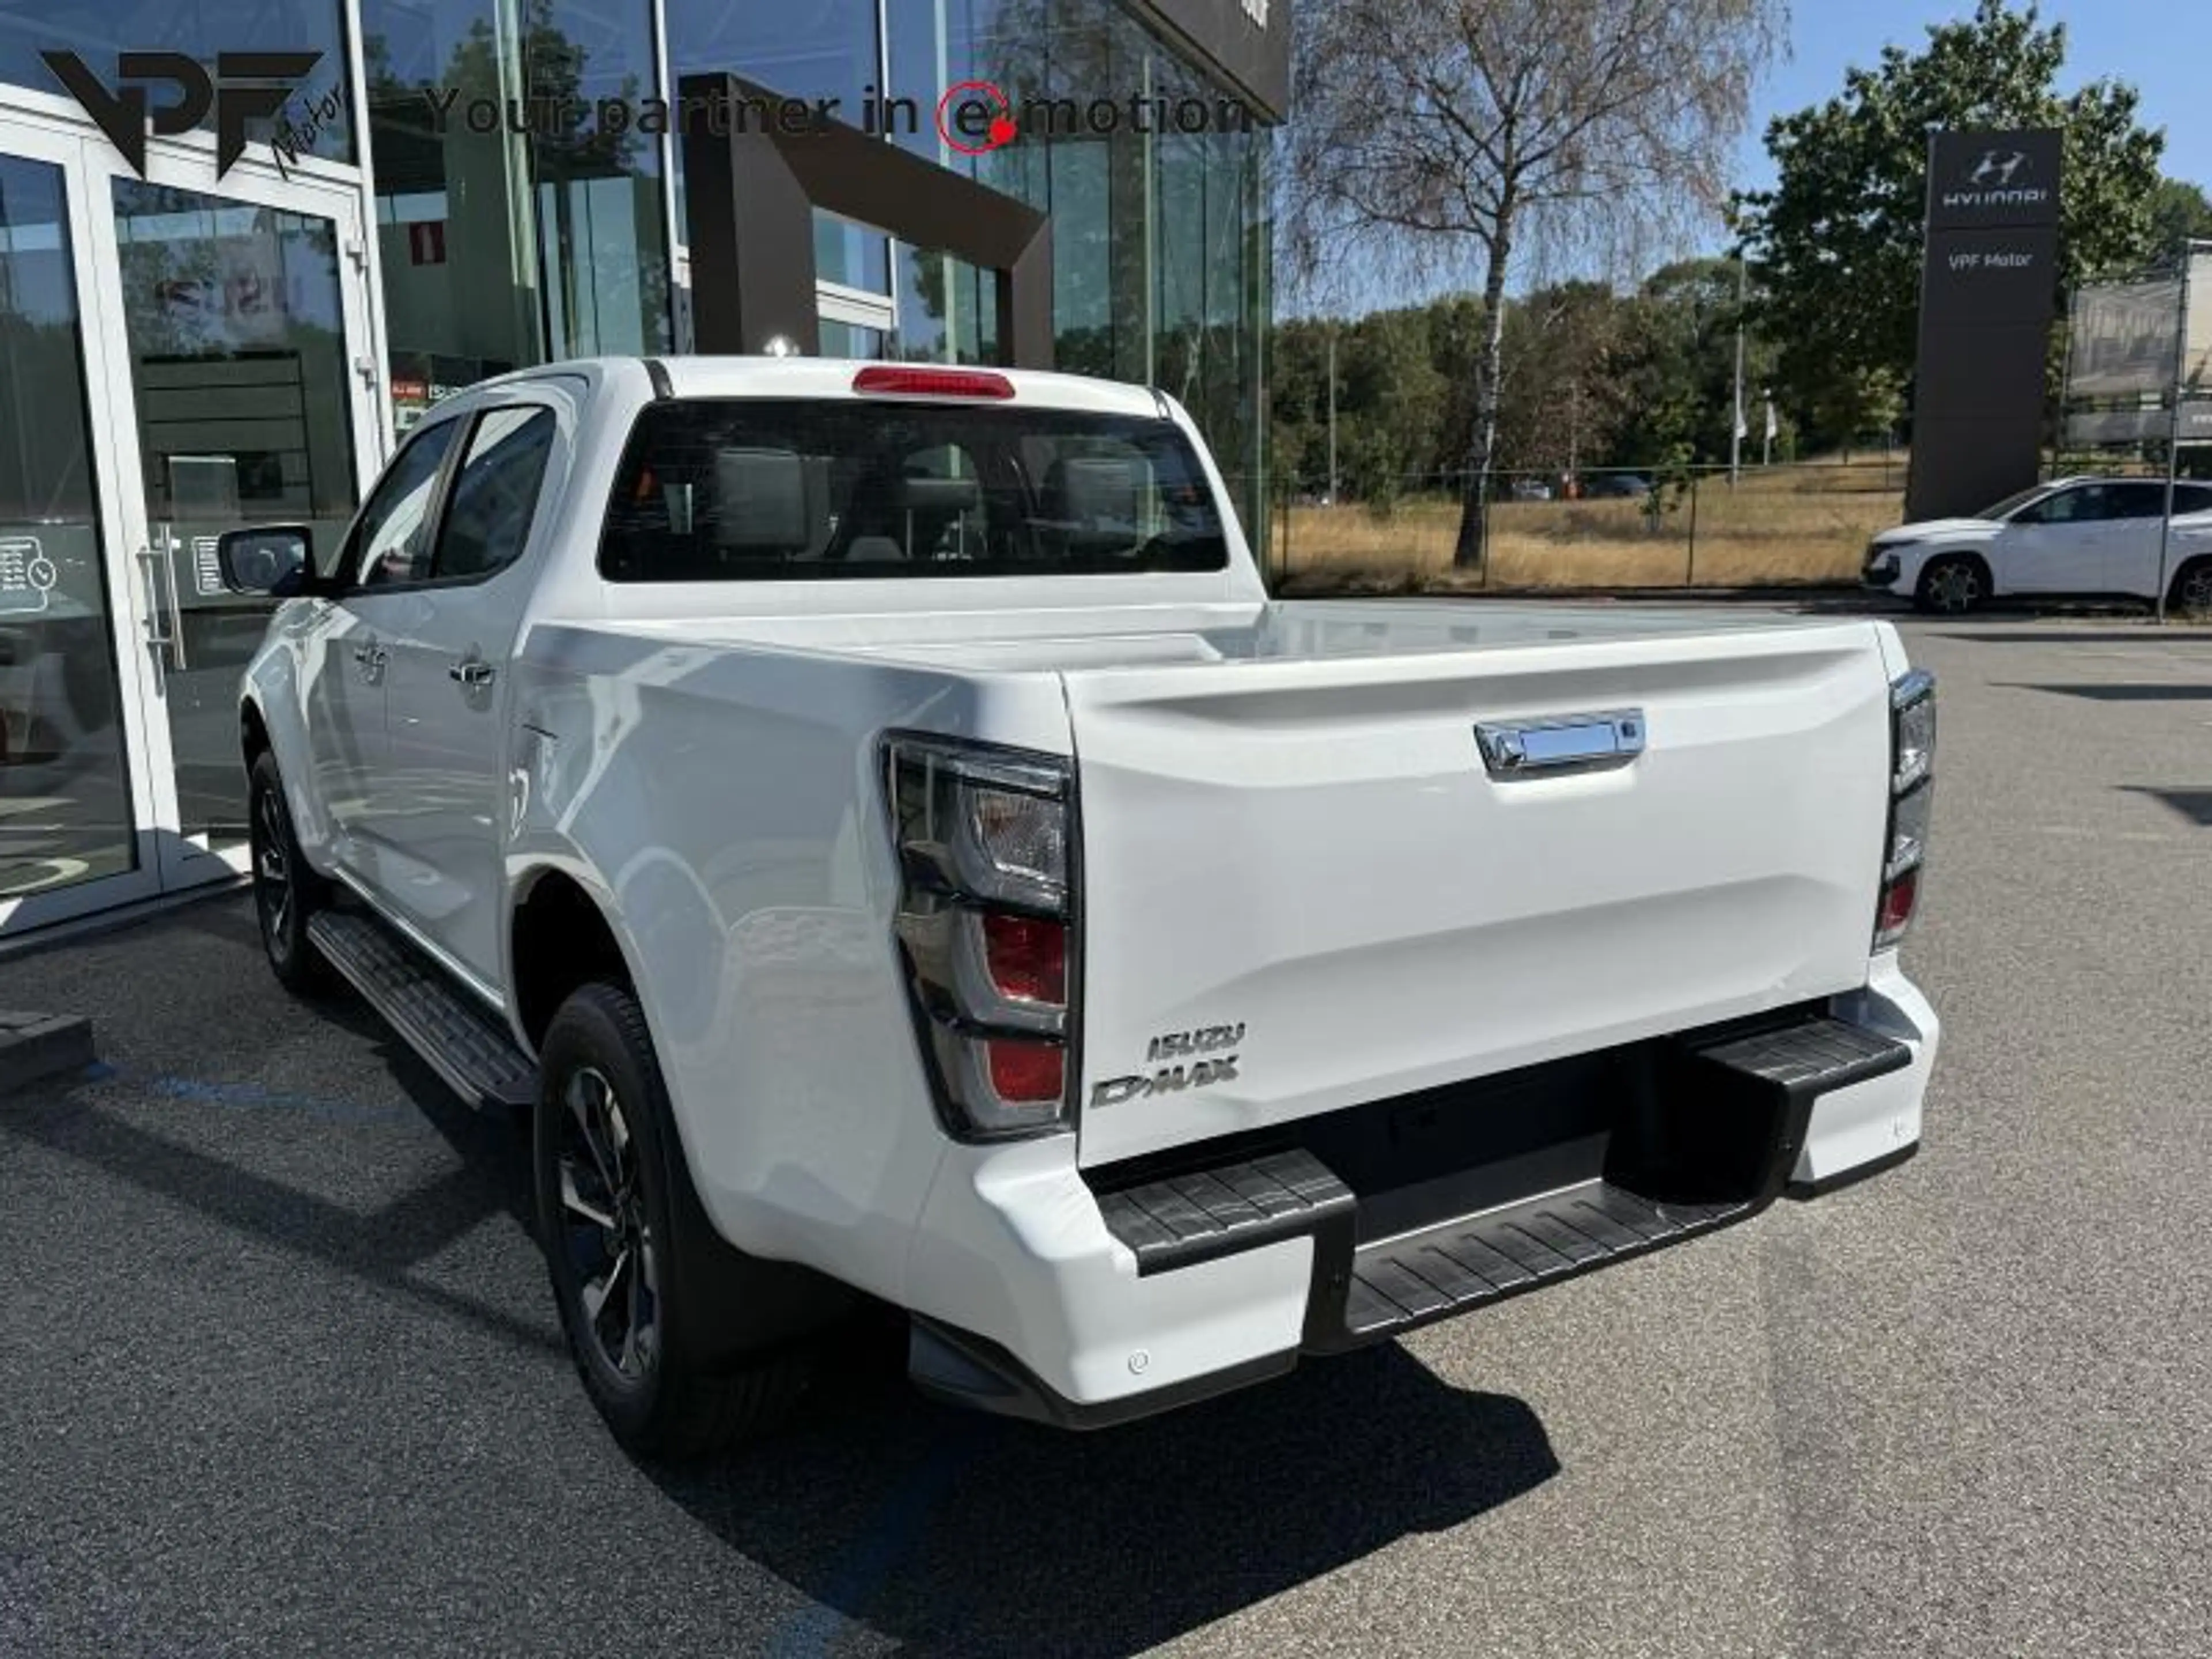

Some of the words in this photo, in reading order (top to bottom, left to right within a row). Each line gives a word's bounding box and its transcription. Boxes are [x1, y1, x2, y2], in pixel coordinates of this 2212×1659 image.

[1942, 188, 2048, 207] HYUNDAI
[1949, 253, 1980, 271] VPF
[1984, 252, 2033, 267] Motor
[1147, 1022, 1246, 1062] ISUZU
